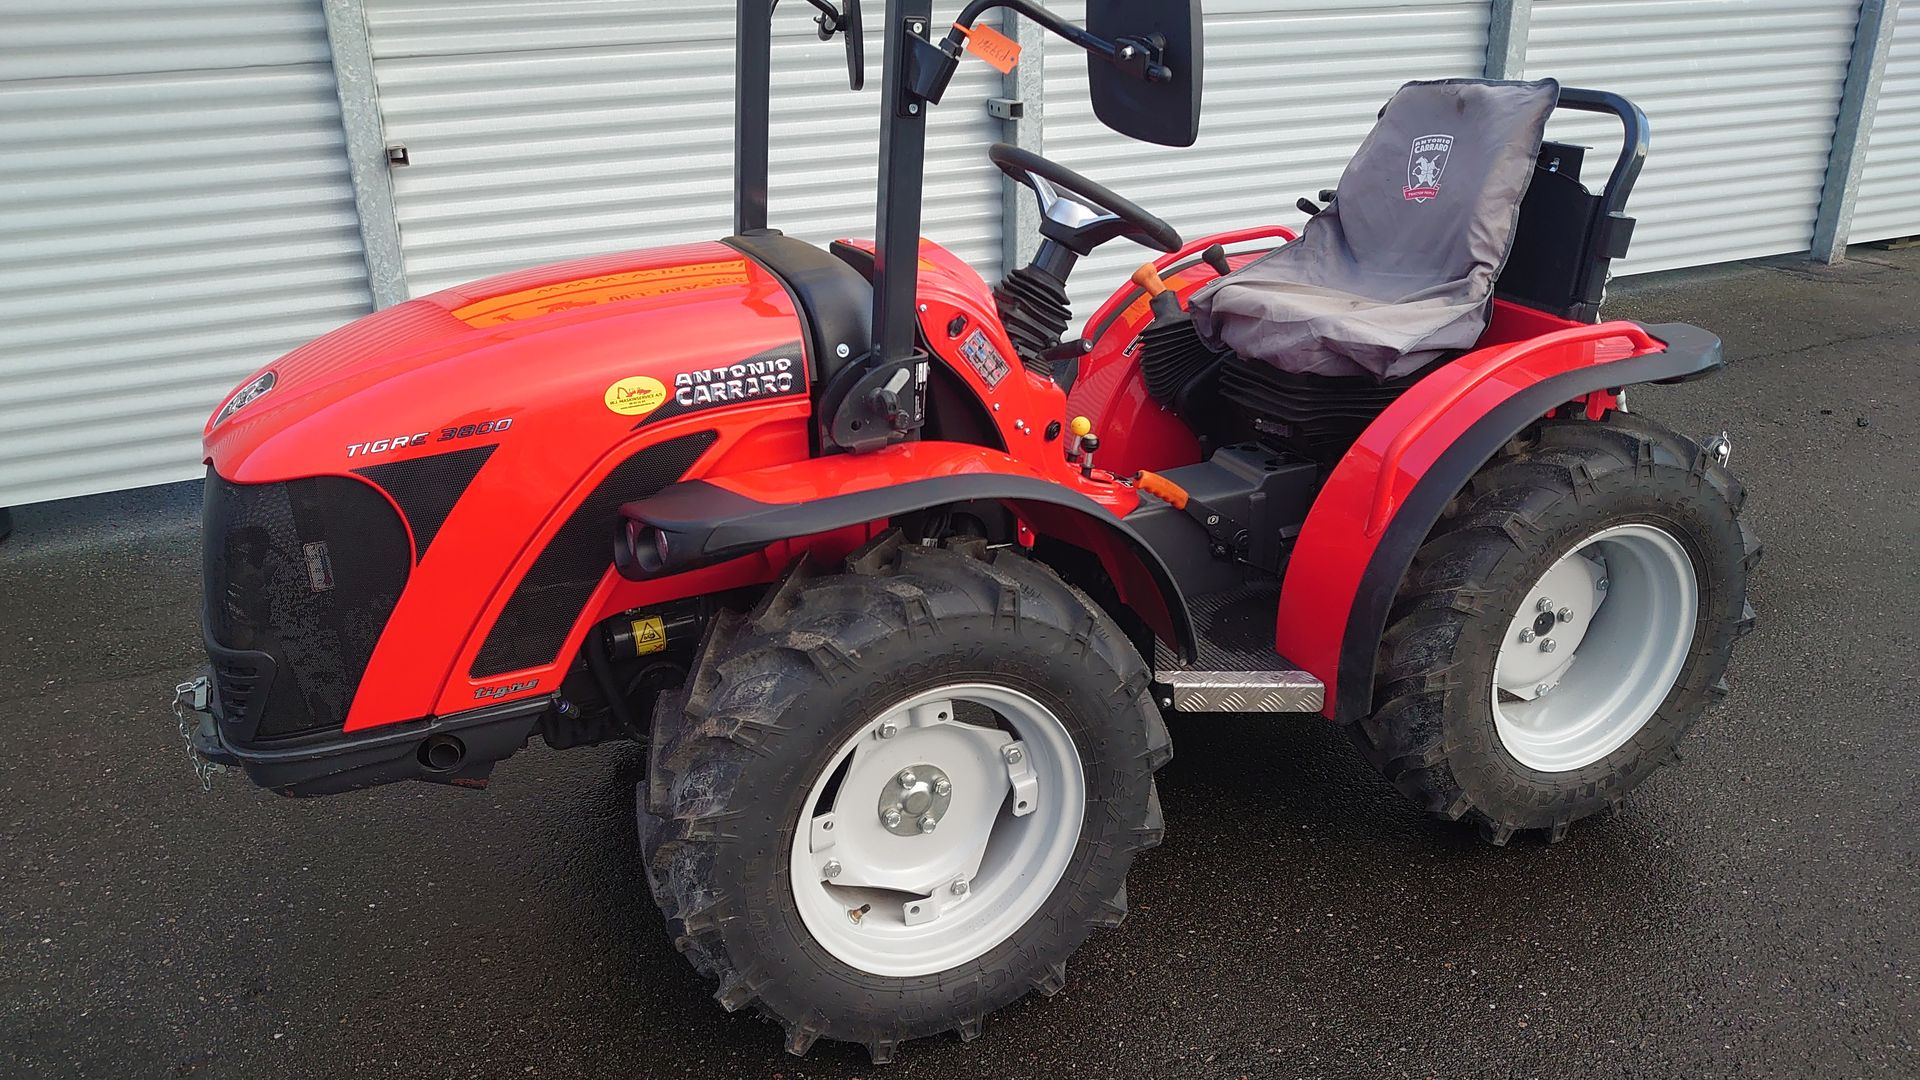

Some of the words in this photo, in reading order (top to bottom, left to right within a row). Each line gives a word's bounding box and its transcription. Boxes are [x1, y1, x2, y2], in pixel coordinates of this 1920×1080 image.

[1414, 143, 1448, 153] CARRARO
[1415, 138, 1450, 146] ANTONIO
[675, 358, 791, 387] ANTONIO
[675, 372, 793, 407] CARRARO
[346, 432, 430, 458] TIGRE
[437, 417, 513, 442] 3800
